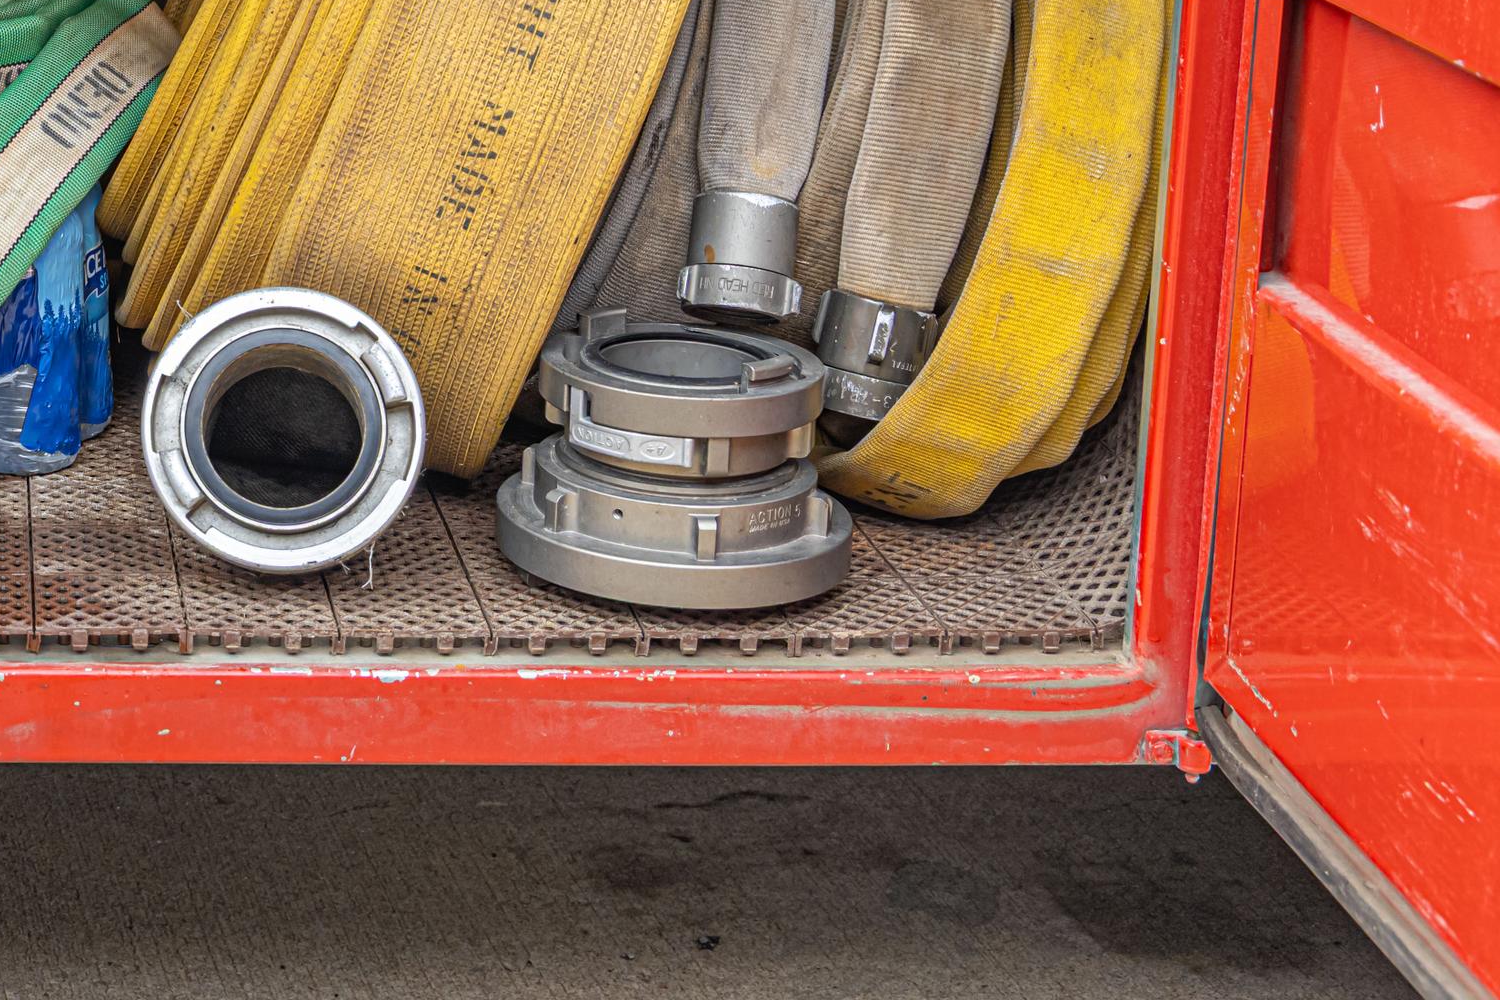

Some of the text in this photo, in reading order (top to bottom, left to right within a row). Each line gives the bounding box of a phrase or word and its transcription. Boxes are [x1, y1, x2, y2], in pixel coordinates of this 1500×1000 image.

[436, 99, 514, 231] MADE
[717, 277, 749, 293] HEAD
[749, 503, 792, 526] ACTION
